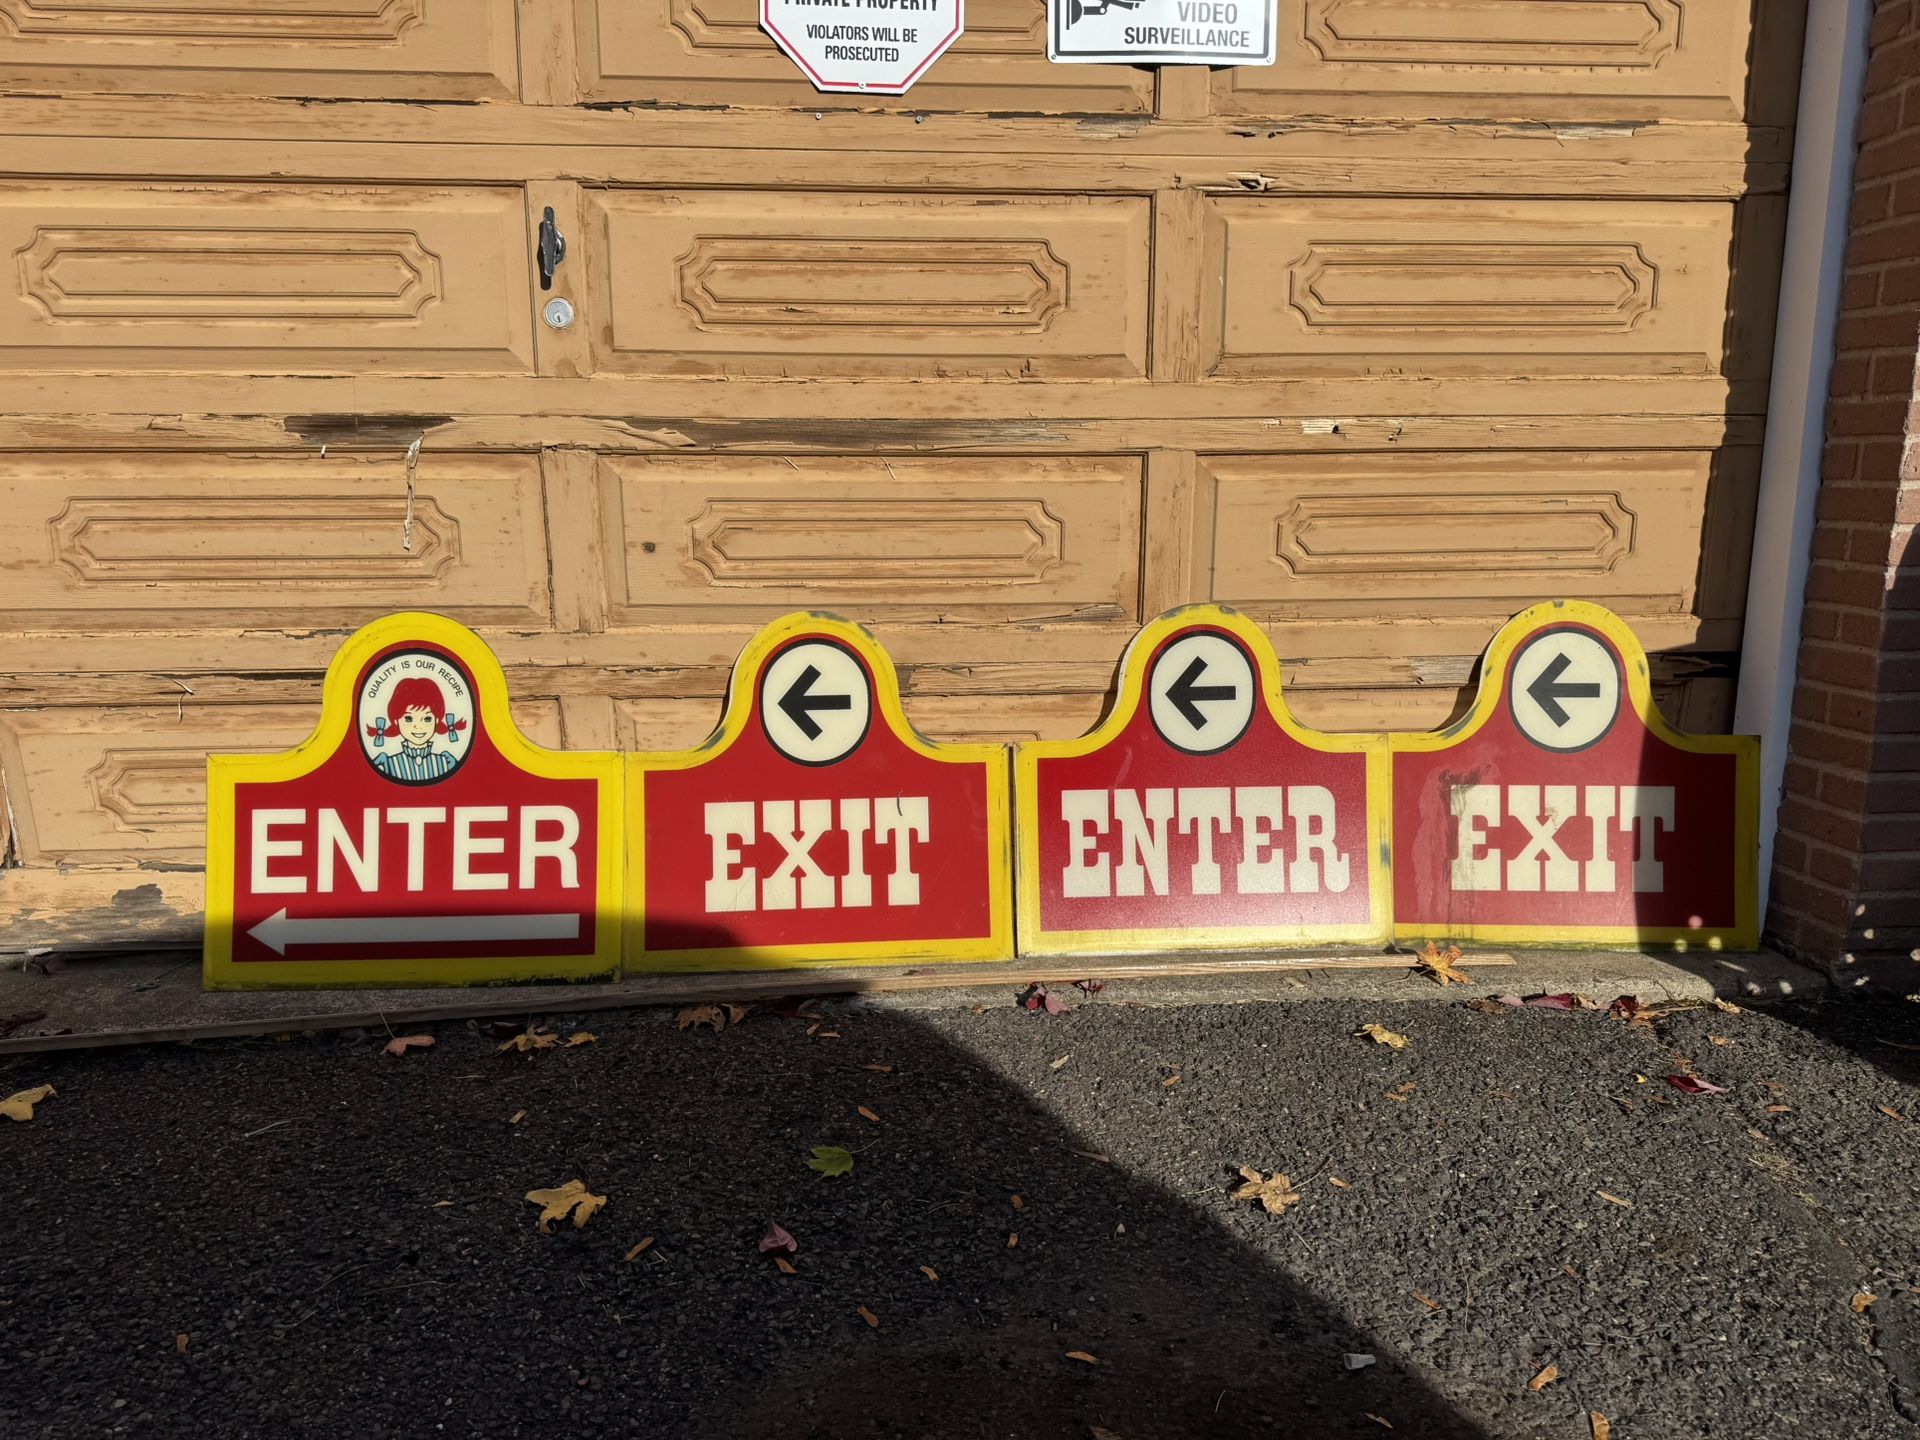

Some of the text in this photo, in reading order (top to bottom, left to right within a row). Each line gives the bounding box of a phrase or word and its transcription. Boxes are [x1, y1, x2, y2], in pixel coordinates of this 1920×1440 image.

[1177, 1, 1238, 24] VIDEO
[806, 24, 918, 43] VIOLATORS WILL BE
[825, 45, 899, 62] PROSECUTED
[1124, 26, 1250, 48] SURVEILLANCE
[368, 659, 464, 699] QUALITY IS OUR RECIPE
[251, 805, 580, 893] ENTER
[704, 797, 930, 912] EXIT
[1061, 786, 1350, 898] ENTER
[1450, 785, 1675, 892] EXIT
